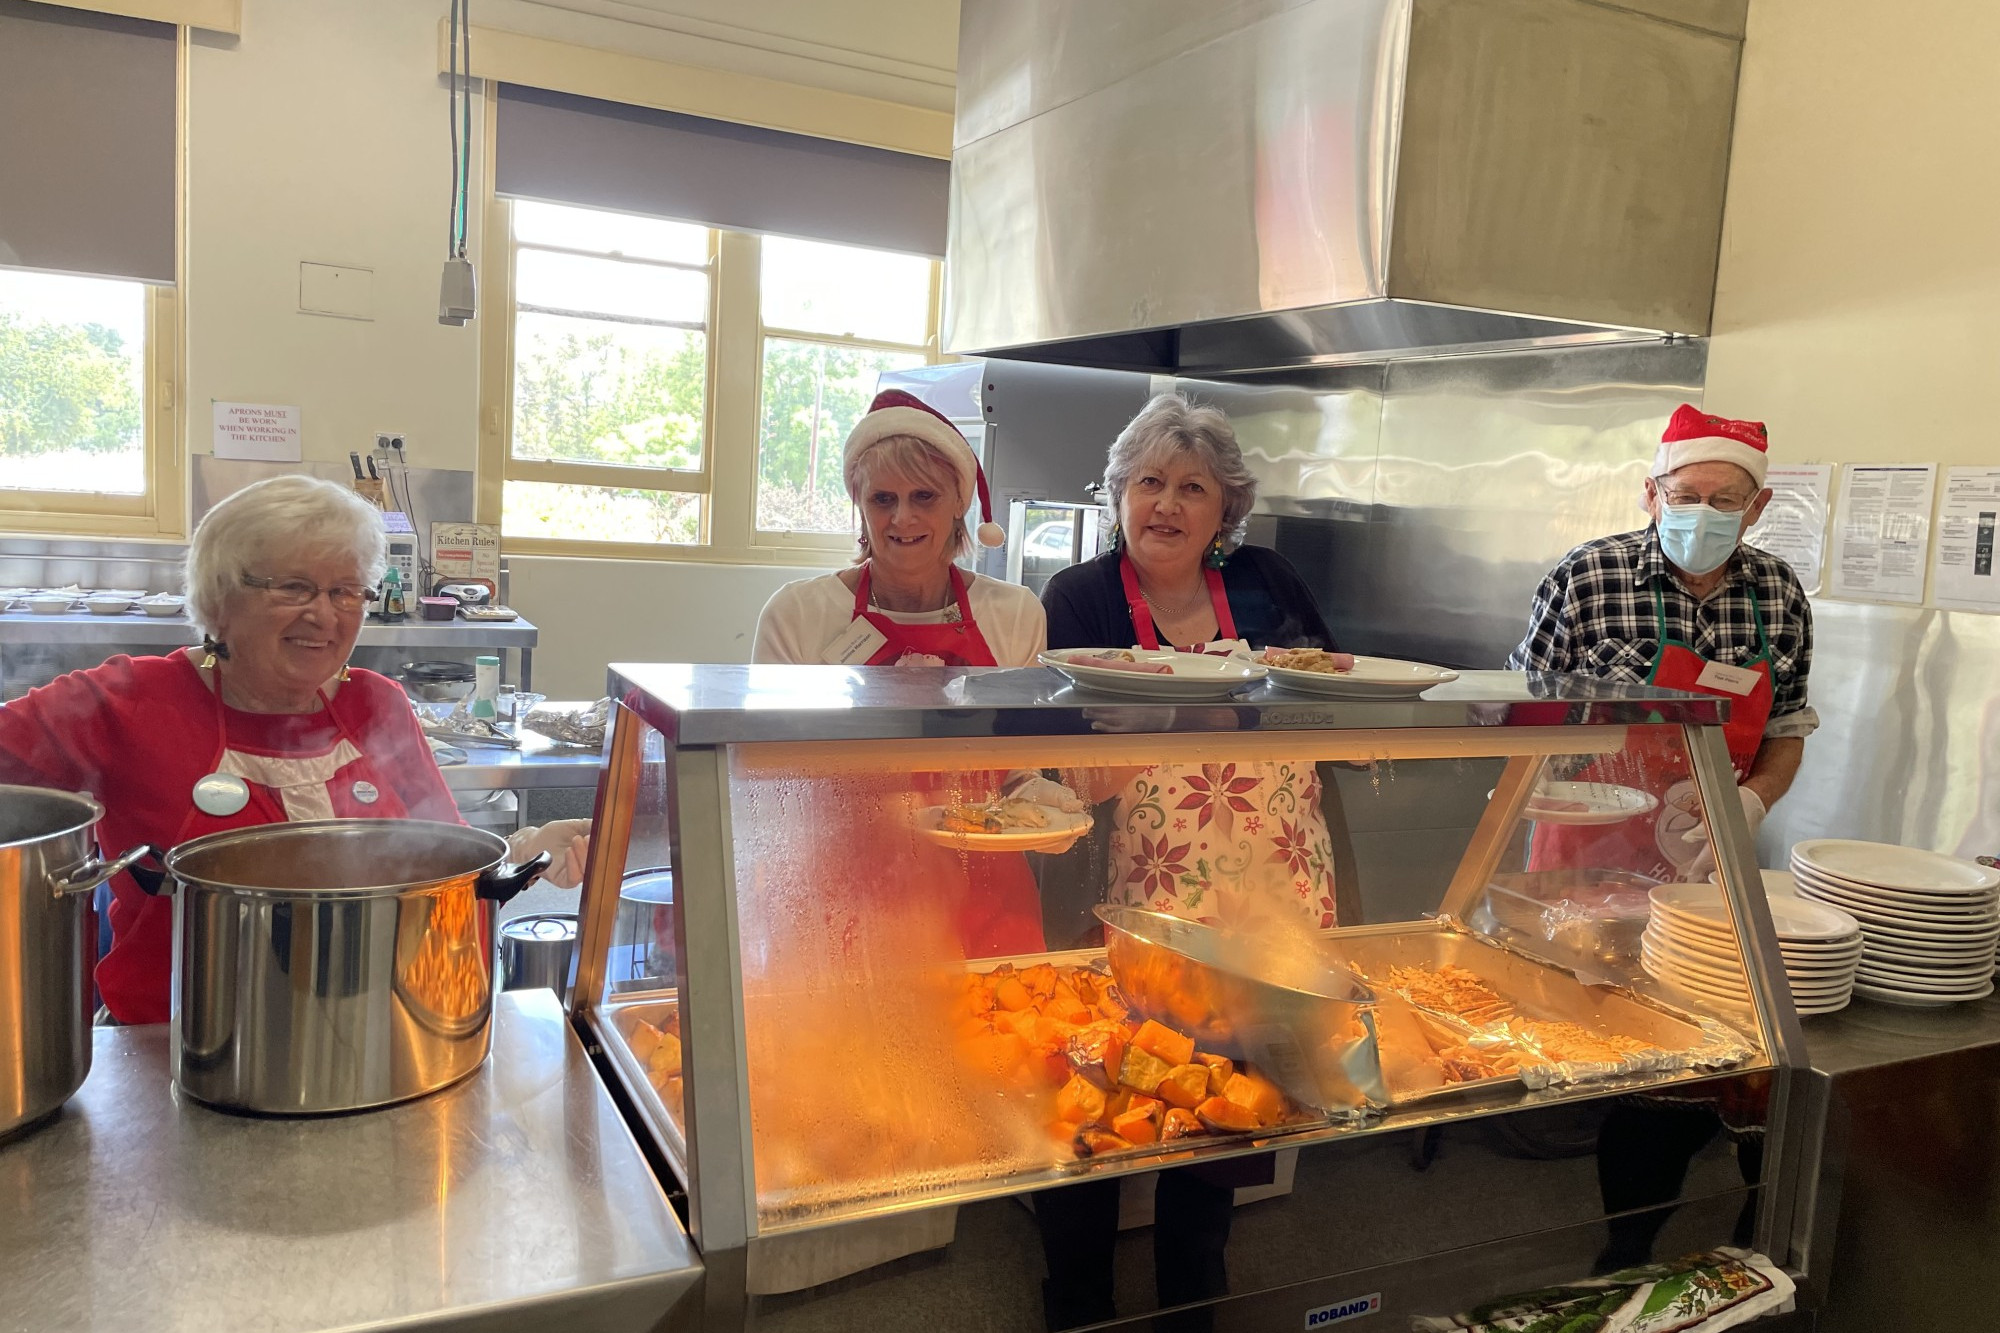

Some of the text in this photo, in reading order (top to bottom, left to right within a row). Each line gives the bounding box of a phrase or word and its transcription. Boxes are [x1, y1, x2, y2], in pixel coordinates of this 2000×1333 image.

[264, 410, 287, 418] MUST
[246, 426, 286, 434] WORKING
[249, 434, 286, 442] KITCHEN
[437, 536, 495, 546] Kitchen Rules
[1308, 1300, 1369, 1326] ROBAND
